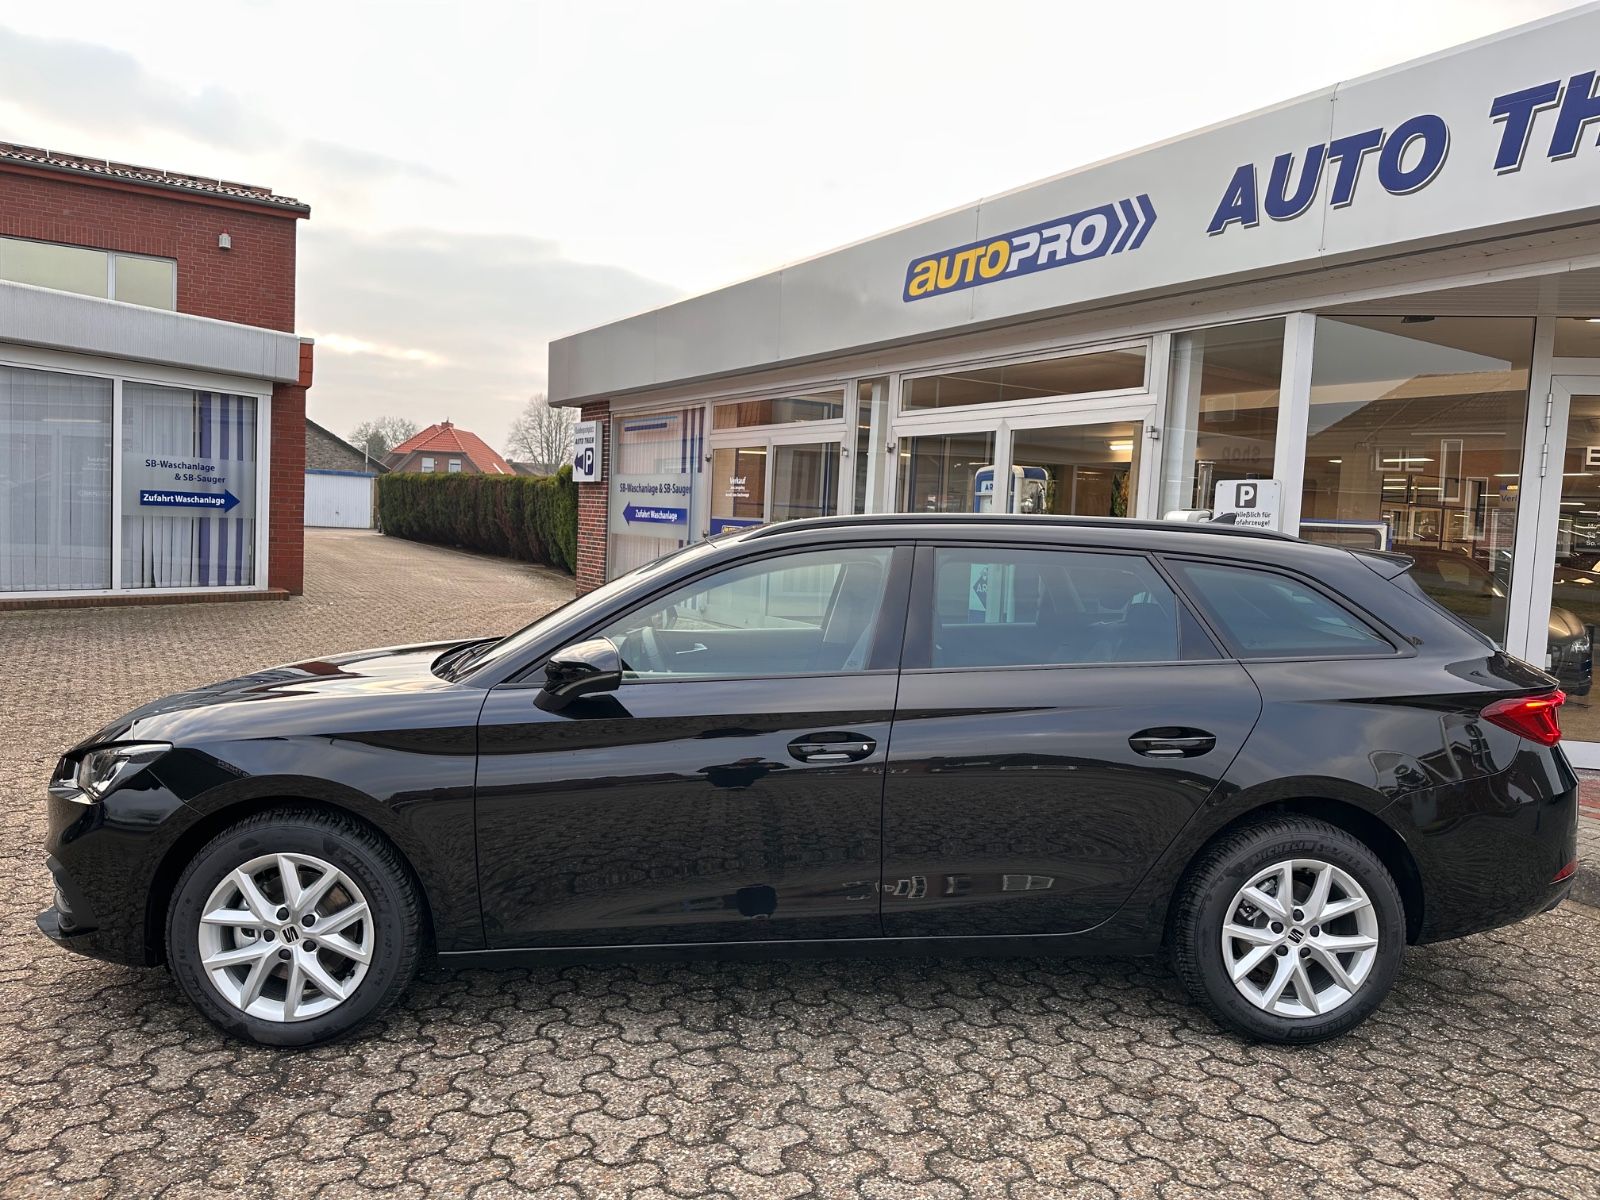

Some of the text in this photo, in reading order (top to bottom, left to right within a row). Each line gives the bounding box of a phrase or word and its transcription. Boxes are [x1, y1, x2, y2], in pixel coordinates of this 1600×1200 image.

[1206, 70, 1600, 236] AUTO TH
[145, 459, 216, 472] SB-Waschanlage
[585, 450, 593, 473] P
[174, 473, 226, 485] & SB-Sauger
[619, 482, 692, 497] SB-Waschanlage & SB-Sauger
[1239, 485, 1255, 507] P
[143, 493, 225, 506] Zufahrt Waschanlage
[635, 509, 678, 522] Zufahrt Waschanlage
[1236, 511, 1271, 519] hließlich für
